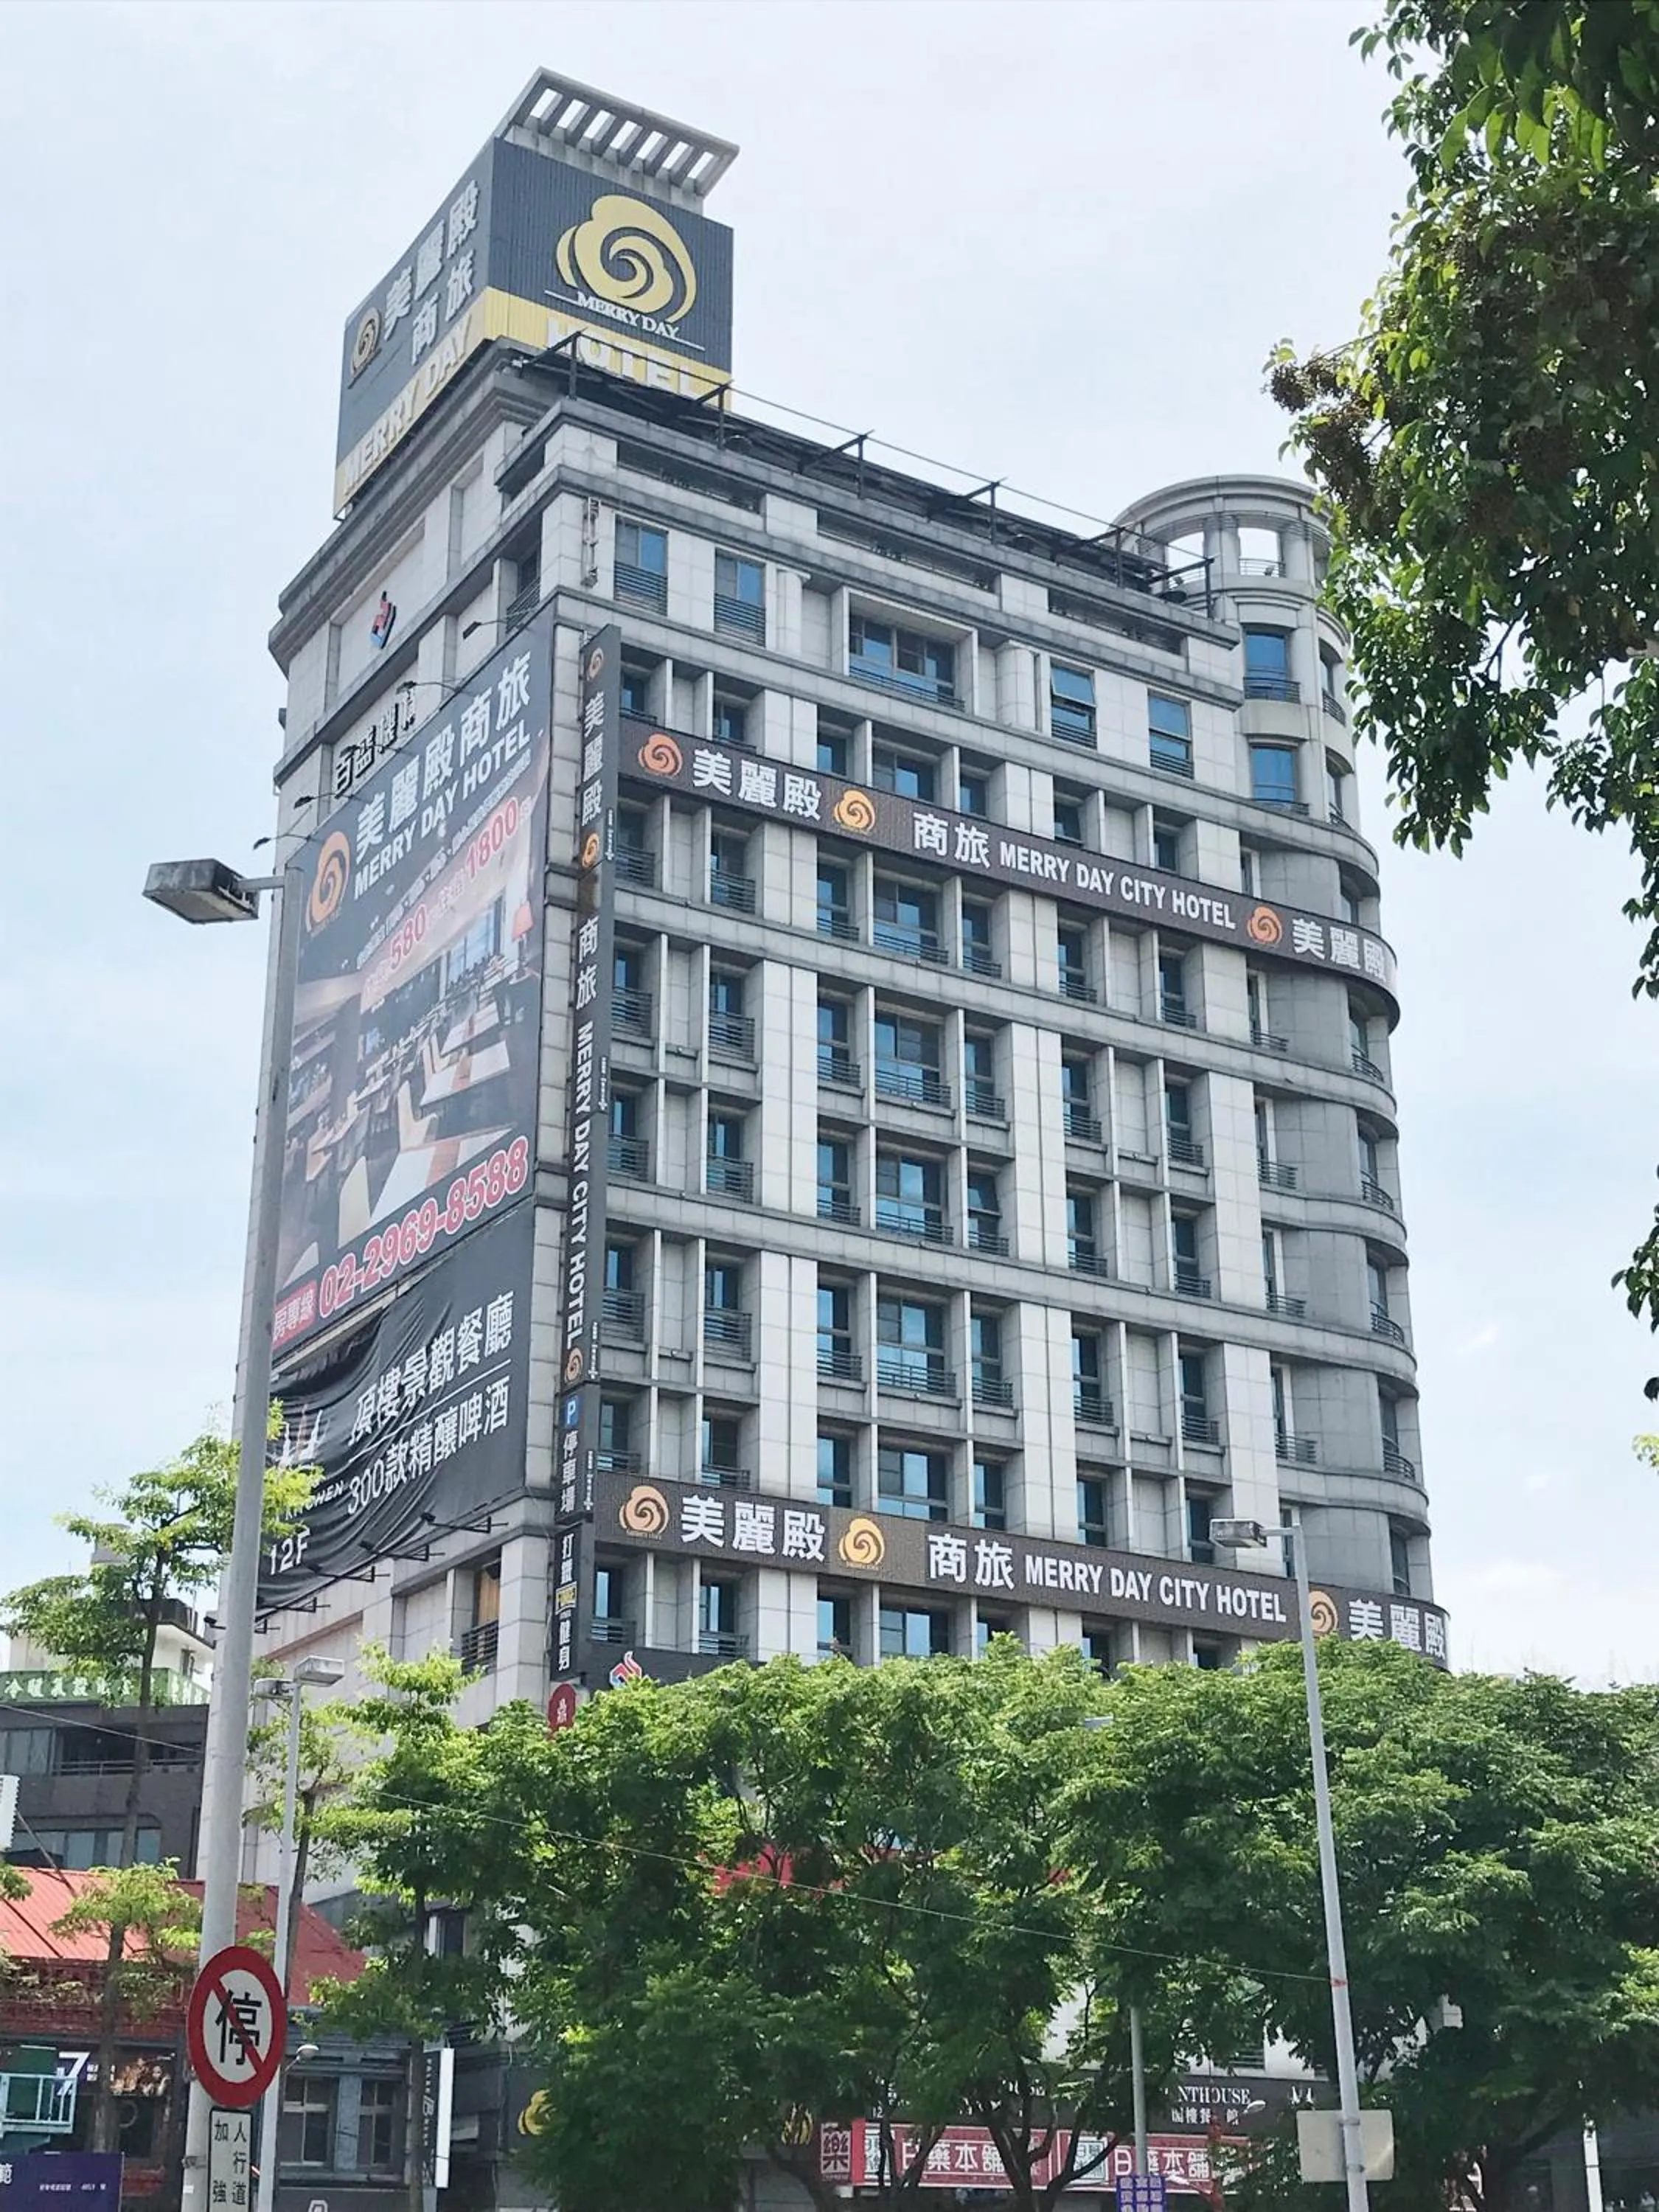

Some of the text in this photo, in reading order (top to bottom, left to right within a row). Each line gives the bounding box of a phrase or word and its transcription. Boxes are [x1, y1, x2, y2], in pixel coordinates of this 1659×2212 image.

[385, 179, 479, 341] 美麗殿
[411, 249, 475, 366] 商旅
[577, 291, 679, 341] MERRY DAY
[343, 313, 473, 496] MERRY DAY
[354, 819, 417, 901] MERRY
[421, 780, 459, 839] DAY
[462, 720, 531, 801] HOTEL
[355, 650, 531, 864] 美麗殿商旅
[582, 691, 605, 826] 美麗殿
[465, 796, 518, 882] 1800
[692, 748, 1237, 930] 美麗殿 商旅 MERRY DAY CITY HOTEL
[566, 916, 599, 1349] 商旅 MERRY DAY CITY HOTEL
[319, 1135, 529, 1318] 02-2969-8588
[347, 1376, 510, 1515] 300款精釀啤酒
[560, 1430, 578, 1512] 停車場
[565, 1401, 577, 1425] P
[269, 1527, 310, 1576] 12F
[679, 1494, 1287, 1624] 美麗殿 商旅 MERRY DAY CITY HOTEL
[1349, 1599, 1445, 1660] 美麗殿
[215, 1992, 262, 2065] 停
[232, 2121, 248, 2205] 人行道
